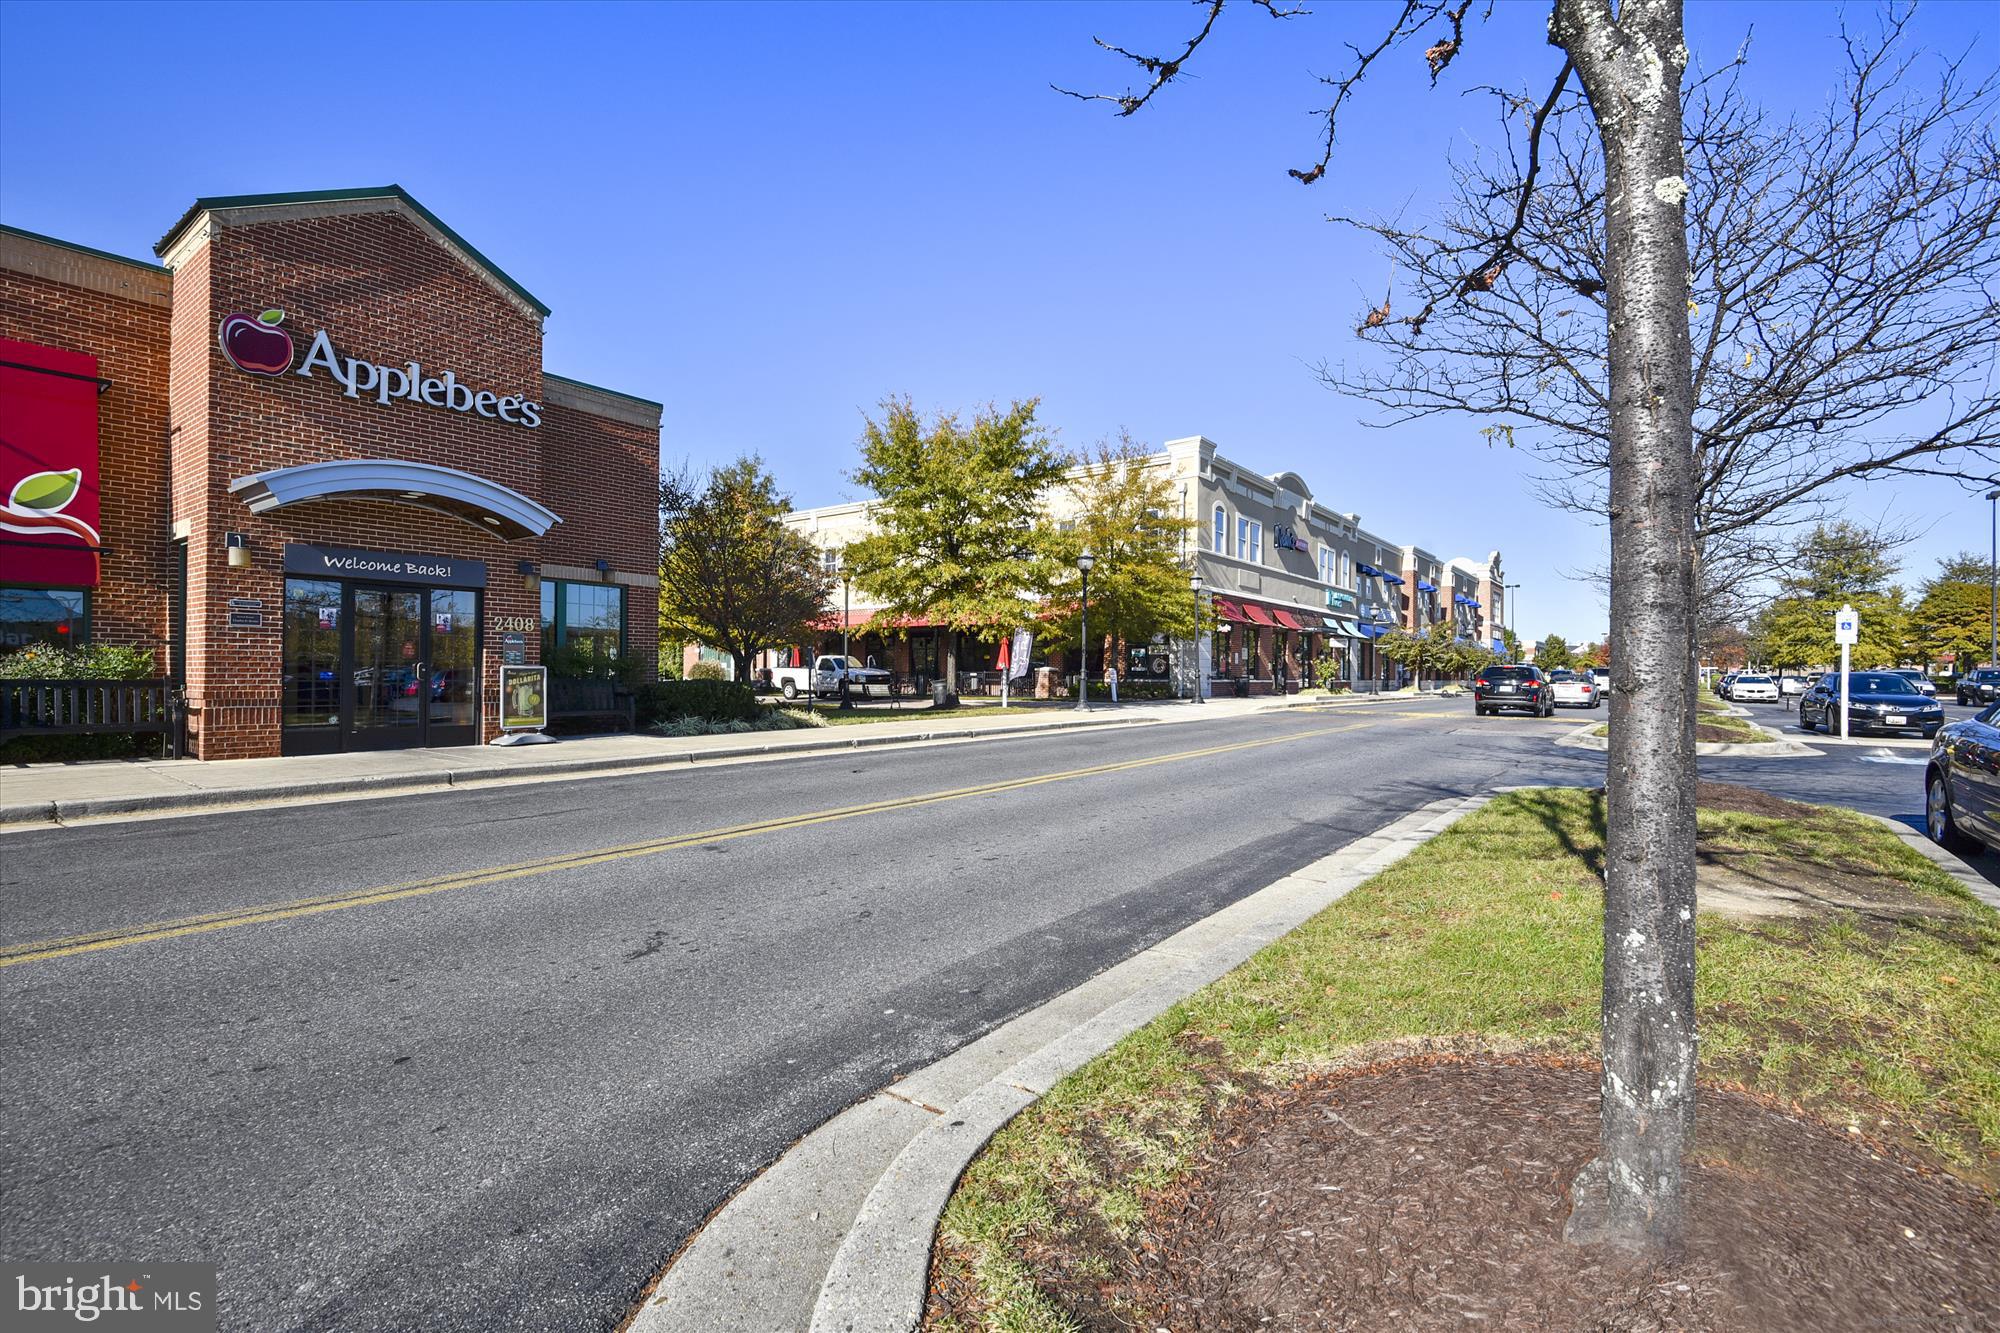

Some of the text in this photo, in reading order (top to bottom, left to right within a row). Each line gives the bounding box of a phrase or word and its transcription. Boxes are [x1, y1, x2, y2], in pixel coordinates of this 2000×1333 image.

[296, 329, 543, 428] Applebee's
[324, 555, 451, 577] Welcome Back!
[495, 617, 534, 631] 2408
